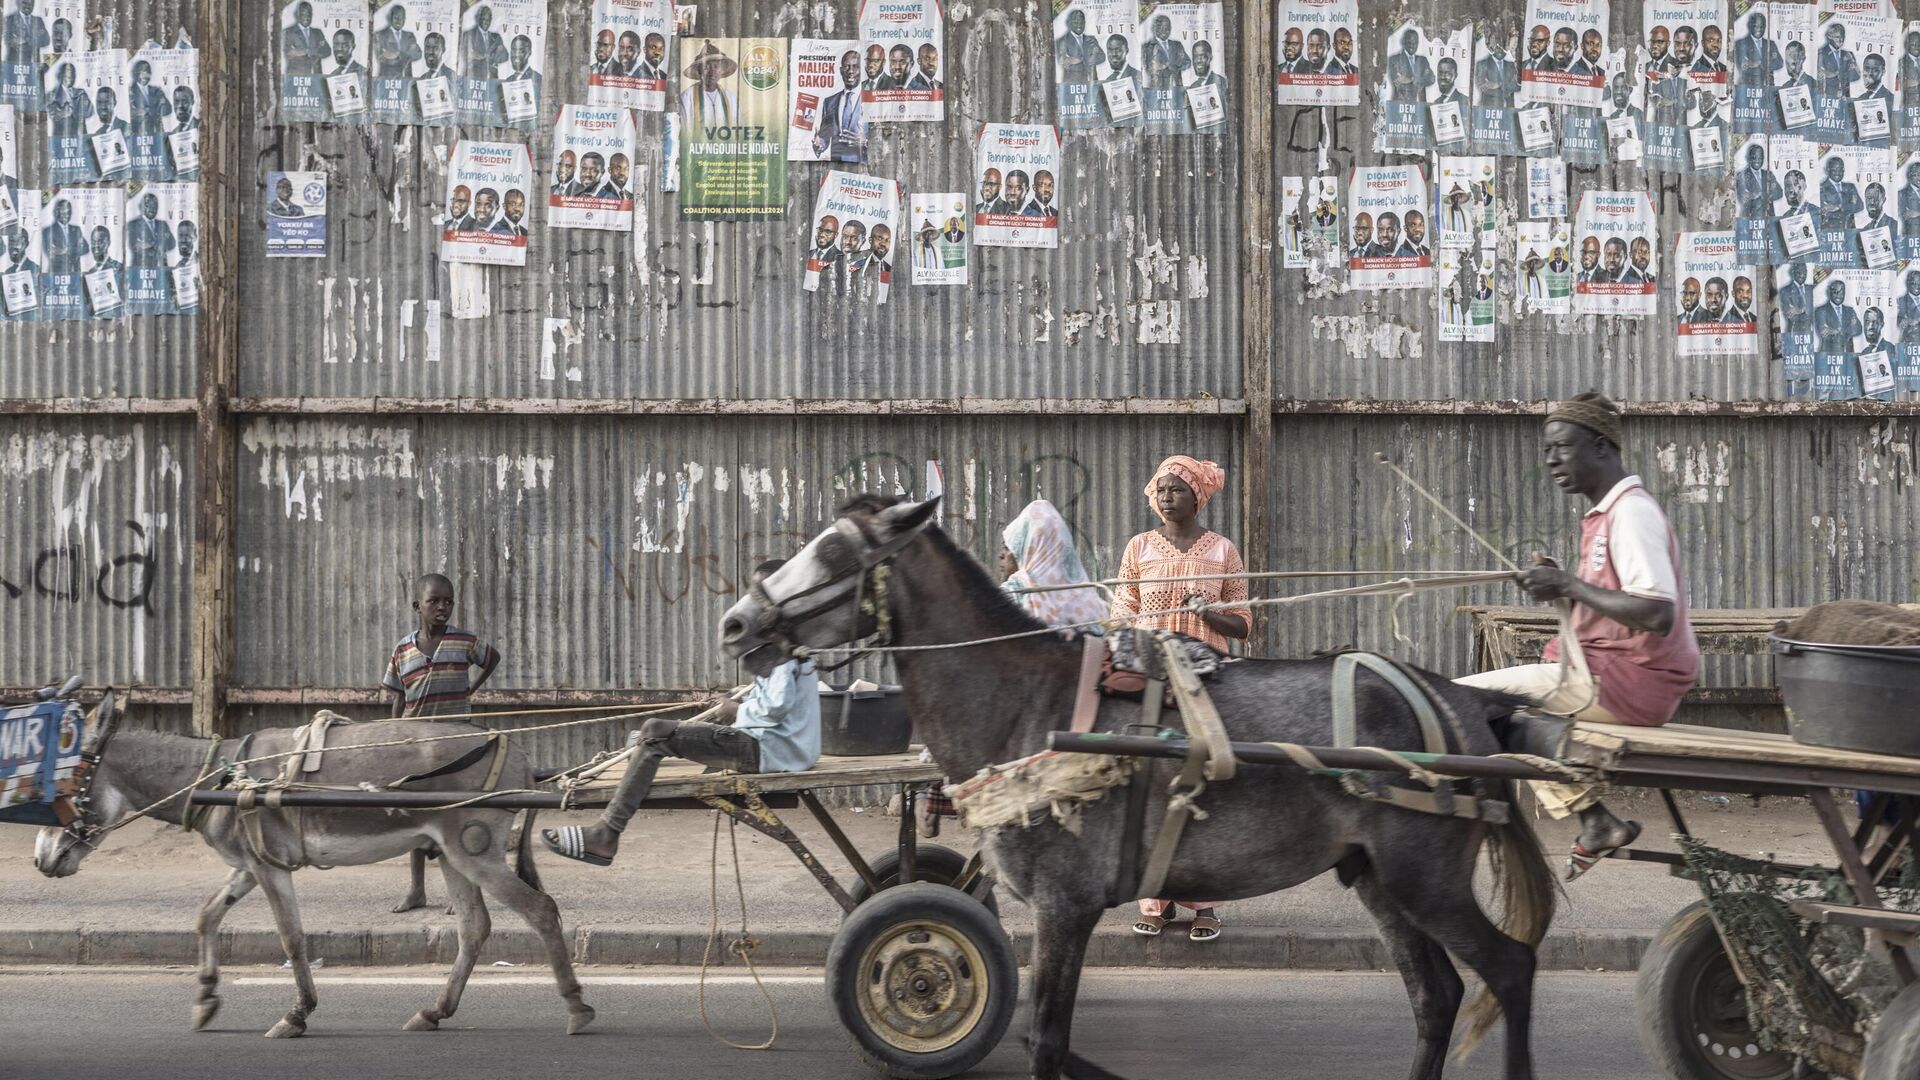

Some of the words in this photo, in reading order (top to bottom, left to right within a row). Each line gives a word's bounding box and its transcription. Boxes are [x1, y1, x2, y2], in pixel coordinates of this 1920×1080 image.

[44, 7, 81, 19] VOTE
[880, 4, 923, 12] DIOMAYE
[323, 19, 364, 29] VOTE
[416, 22, 454, 33] VOTE
[1096, 23, 1136, 35] VOTE
[502, 23, 542, 36] VOTE
[1182, 30, 1220, 40] VOTE
[1776, 30, 1814, 41] VOTE
[1428, 47, 1466, 59] VOTE
[1855, 42, 1894, 56] VOTE
[13, 64, 30, 75] DEM
[798, 62, 835, 74] MALICK
[16, 75, 26, 84] AK
[86, 76, 124, 87] VOTE
[293, 76, 312, 86] DEM
[385, 79, 402, 89] DEM
[798, 74, 834, 88] GAKOU
[2, 84, 37, 96] DIOMAYE
[470, 80, 487, 90] DEM
[1070, 84, 1087, 94] DEM
[297, 87, 308, 96] AK
[388, 89, 398, 99] AK
[472, 90, 484, 100] AK
[1157, 90, 1172, 100] DEM
[1746, 88, 1763, 98] DEM
[284, 96, 320, 107] DIOMAYE
[374, 99, 409, 110] DIOMAYE
[1074, 95, 1085, 104] AK
[1161, 100, 1169, 109] AK
[1750, 98, 1760, 108] AK
[1820, 98, 1839, 108] DEM
[458, 99, 493, 111] DIOMAYE
[1061, 104, 1096, 115] DIOMAYE
[1399, 104, 1416, 113] DEM
[575, 111, 617, 120] DIOMAYE
[1147, 110, 1181, 120] DIOMAYE
[1485, 110, 1503, 120] DEM
[1735, 108, 1771, 119] DIOMAYE
[1823, 108, 1835, 118] AK
[1402, 114, 1412, 123] AK
[1575, 117, 1591, 128] DEM
[1389, 123, 1423, 135] DIOMAYE
[1488, 120, 1499, 129] AK
[705, 127, 765, 141] VOTEZ
[998, 129, 1040, 138] DIOMAYE
[1474, 129, 1510, 140] DIOMAYE
[1578, 128, 1587, 138] AK
[1658, 126, 1675, 137] DEM
[61, 138, 78, 148] DEM
[136, 135, 154, 146] DEM
[1564, 137, 1598, 149] DIOMAYE
[1661, 136, 1671, 146] AK
[64, 148, 75, 158] AK
[141, 146, 152, 155] AK
[470, 147, 512, 156] DIOMAYE
[689, 143, 705, 155] ALY
[706, 143, 748, 155] NGOUILLE
[748, 143, 779, 155] NDIAYE
[1647, 145, 1682, 158] DIOMAYE
[51, 157, 86, 169] DIOMAYE
[1774, 159, 1814, 170] VOTE
[1366, 171, 1407, 180] DIOMAYE
[1855, 172, 1893, 183] VOTE
[841, 177, 884, 191] DIOMAYE
[1596, 196, 1635, 205] DIOMAYE
[82, 215, 118, 226] VOTE
[1749, 219, 1765, 230] DEM
[1444, 233, 1457, 241] ALY
[1752, 229, 1763, 239] AK
[1827, 231, 1845, 241] DEM
[1739, 240, 1773, 250] DIOMAYE
[1831, 241, 1843, 251] AK
[140, 269, 157, 280] DEM
[916, 270, 929, 278] ALY
[930, 270, 960, 278] NGOUILLE
[55, 275, 71, 286] DEM
[143, 279, 154, 289] AK
[58, 285, 68, 295] AK
[128, 289, 165, 300] DIOMAYE
[46, 295, 80, 305] DIOMAYE
[1855, 296, 1893, 307] VOTE
[1794, 334, 1811, 345] DEM
[1798, 344, 1809, 354] AK
[1827, 355, 1844, 365] DEM
[1830, 365, 1841, 375] AK
[1816, 375, 1852, 386] DIOMAYE
